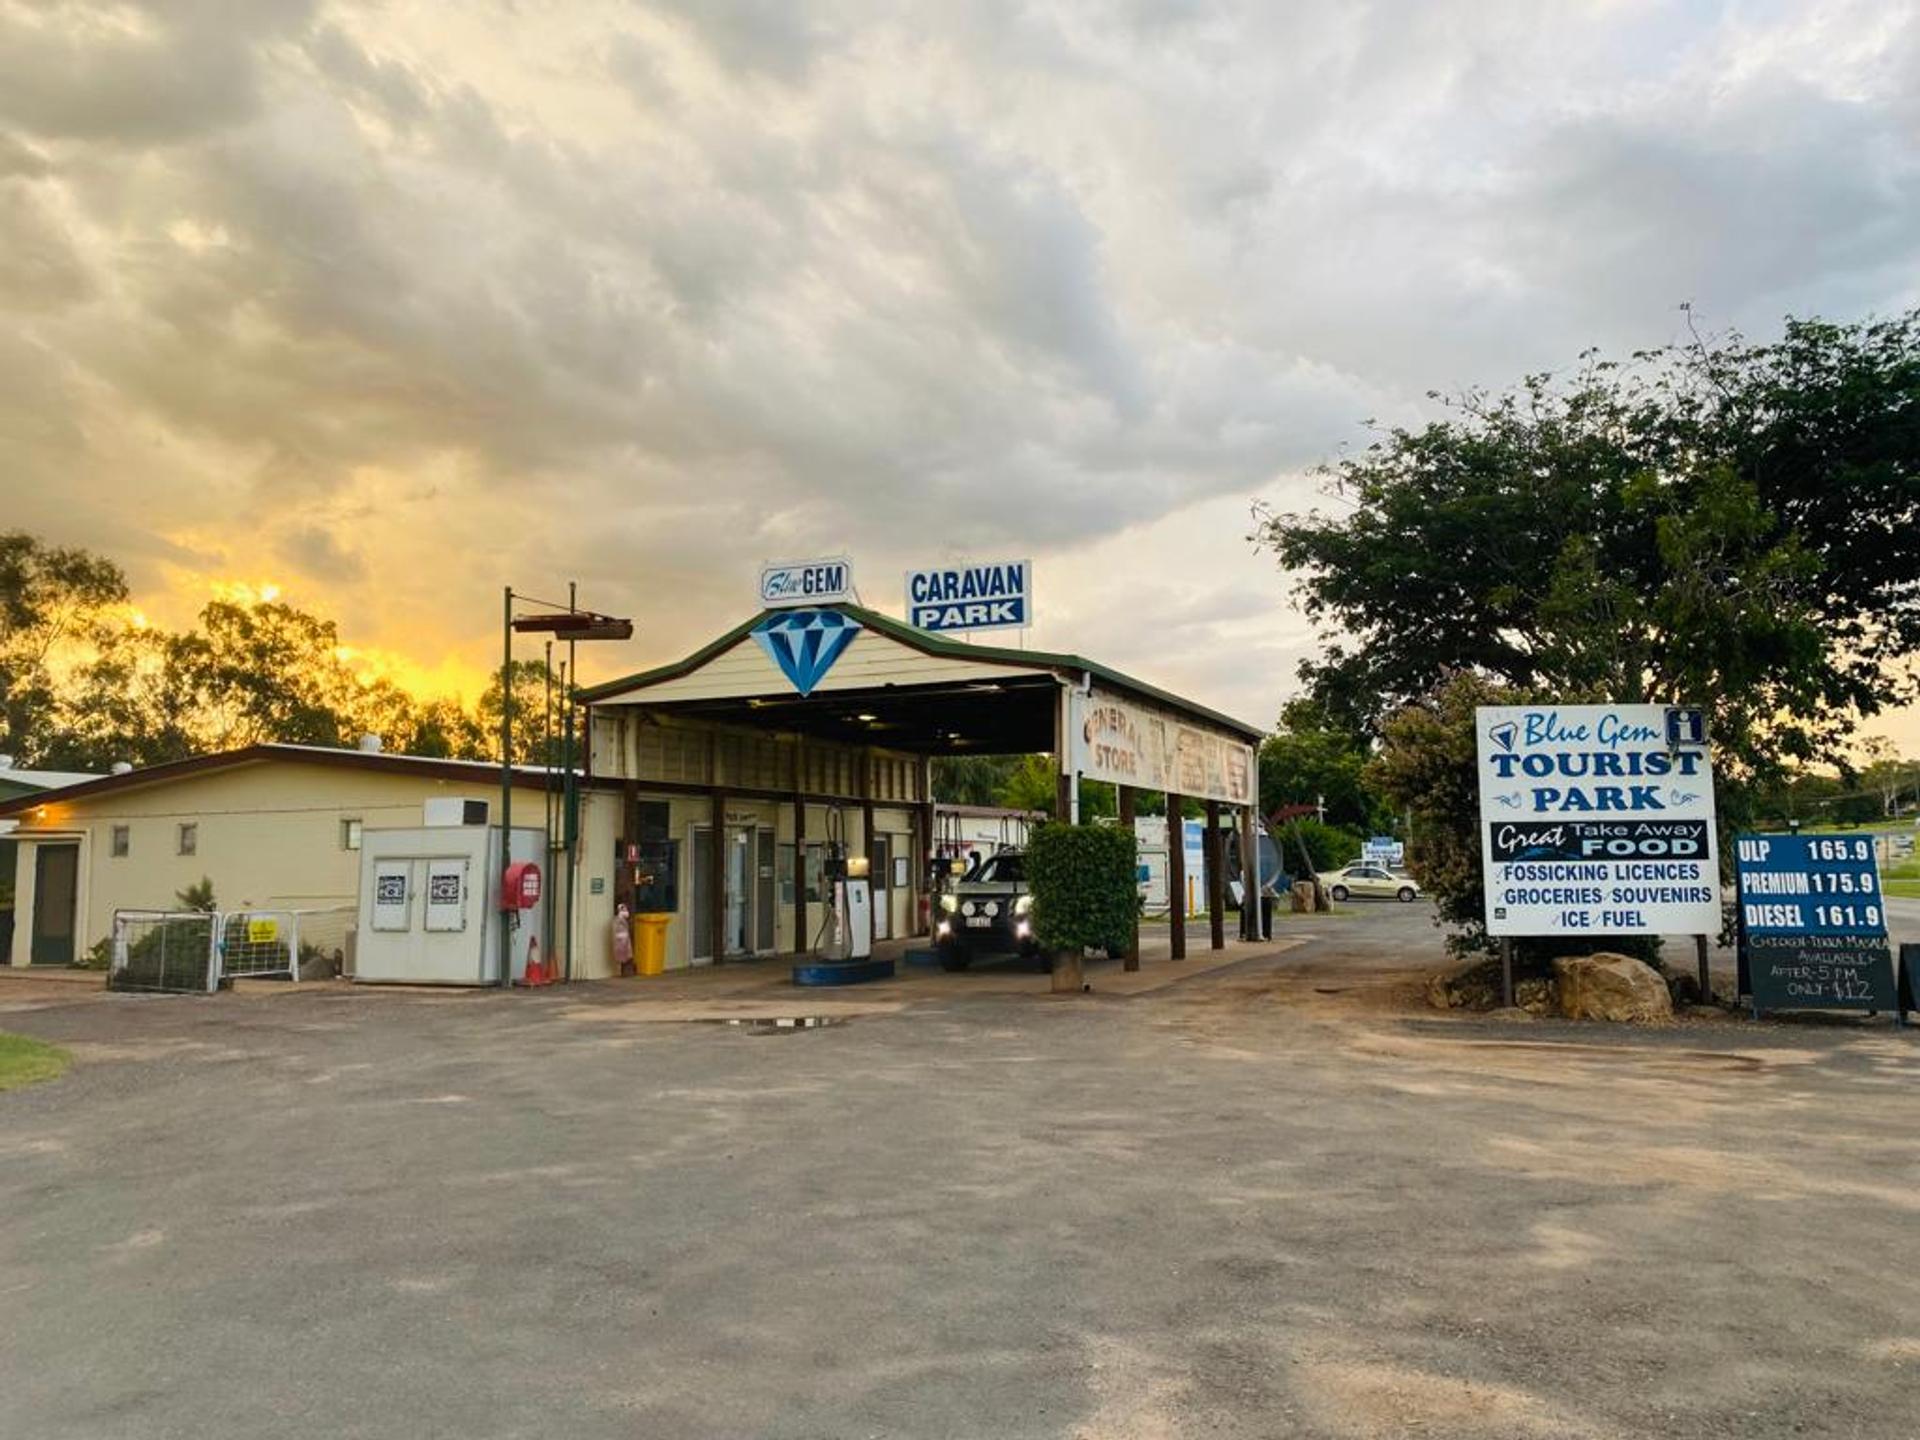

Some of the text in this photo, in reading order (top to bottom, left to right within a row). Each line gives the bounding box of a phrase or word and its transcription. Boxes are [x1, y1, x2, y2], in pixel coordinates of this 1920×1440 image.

[803, 566, 842, 594] GEM
[911, 564, 1023, 603] CARAVAN
[917, 601, 1016, 628] PARK
[1524, 712, 1661, 749] Blue Gem
[1095, 743, 1136, 776] STORE
[1490, 751, 1703, 778] TOURIST
[1531, 785, 1666, 812] PARK
[1497, 822, 1702, 853] Great Take Away
[1581, 838, 1699, 856] FOOD
[1738, 840, 1868, 862] ULP 165.9
[1504, 863, 1700, 882] FOSSICKING LICENCES
[1742, 872, 1874, 894] PREMIUM 175.9
[1504, 886, 1712, 905] GROCERIES SOUVENIRS
[1561, 910, 1646, 927] ICE FUEL
[1745, 904, 1879, 928] DIESEL 161.9
